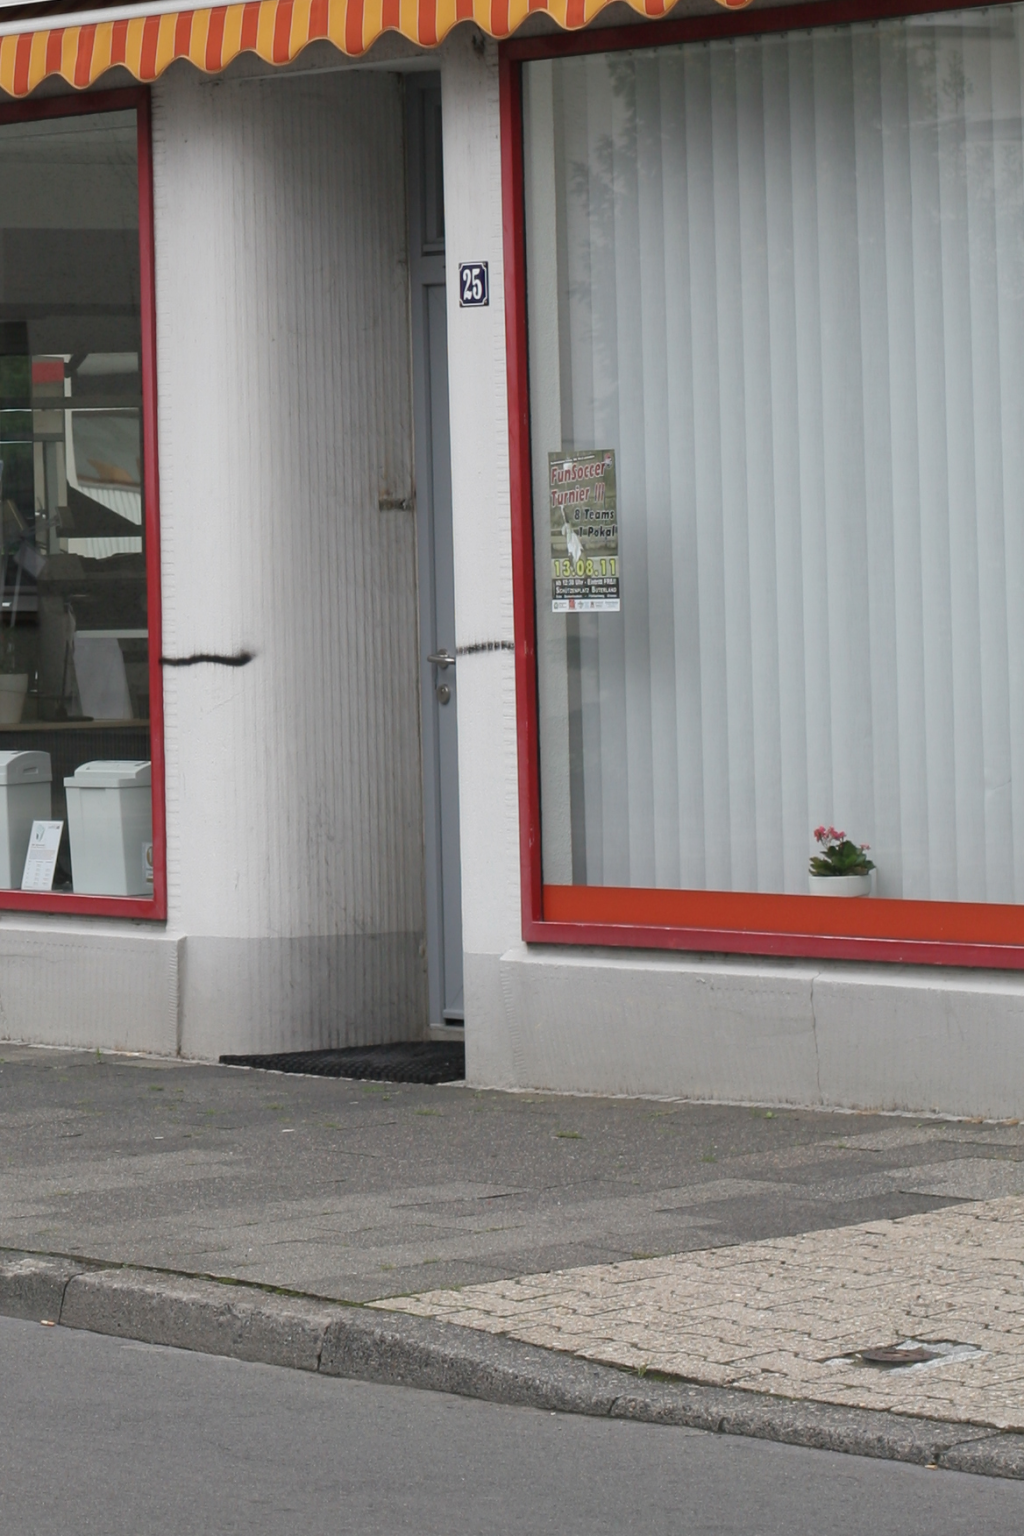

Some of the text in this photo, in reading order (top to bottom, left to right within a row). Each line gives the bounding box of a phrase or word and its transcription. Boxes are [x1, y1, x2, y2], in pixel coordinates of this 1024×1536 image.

[462, 268, 483, 301] 25
[551, 462, 606, 485] FunSoccer
[551, 485, 590, 508] Turnier
[574, 509, 615, 521] 8 Teams
[554, 558, 617, 577] 13.08.11
